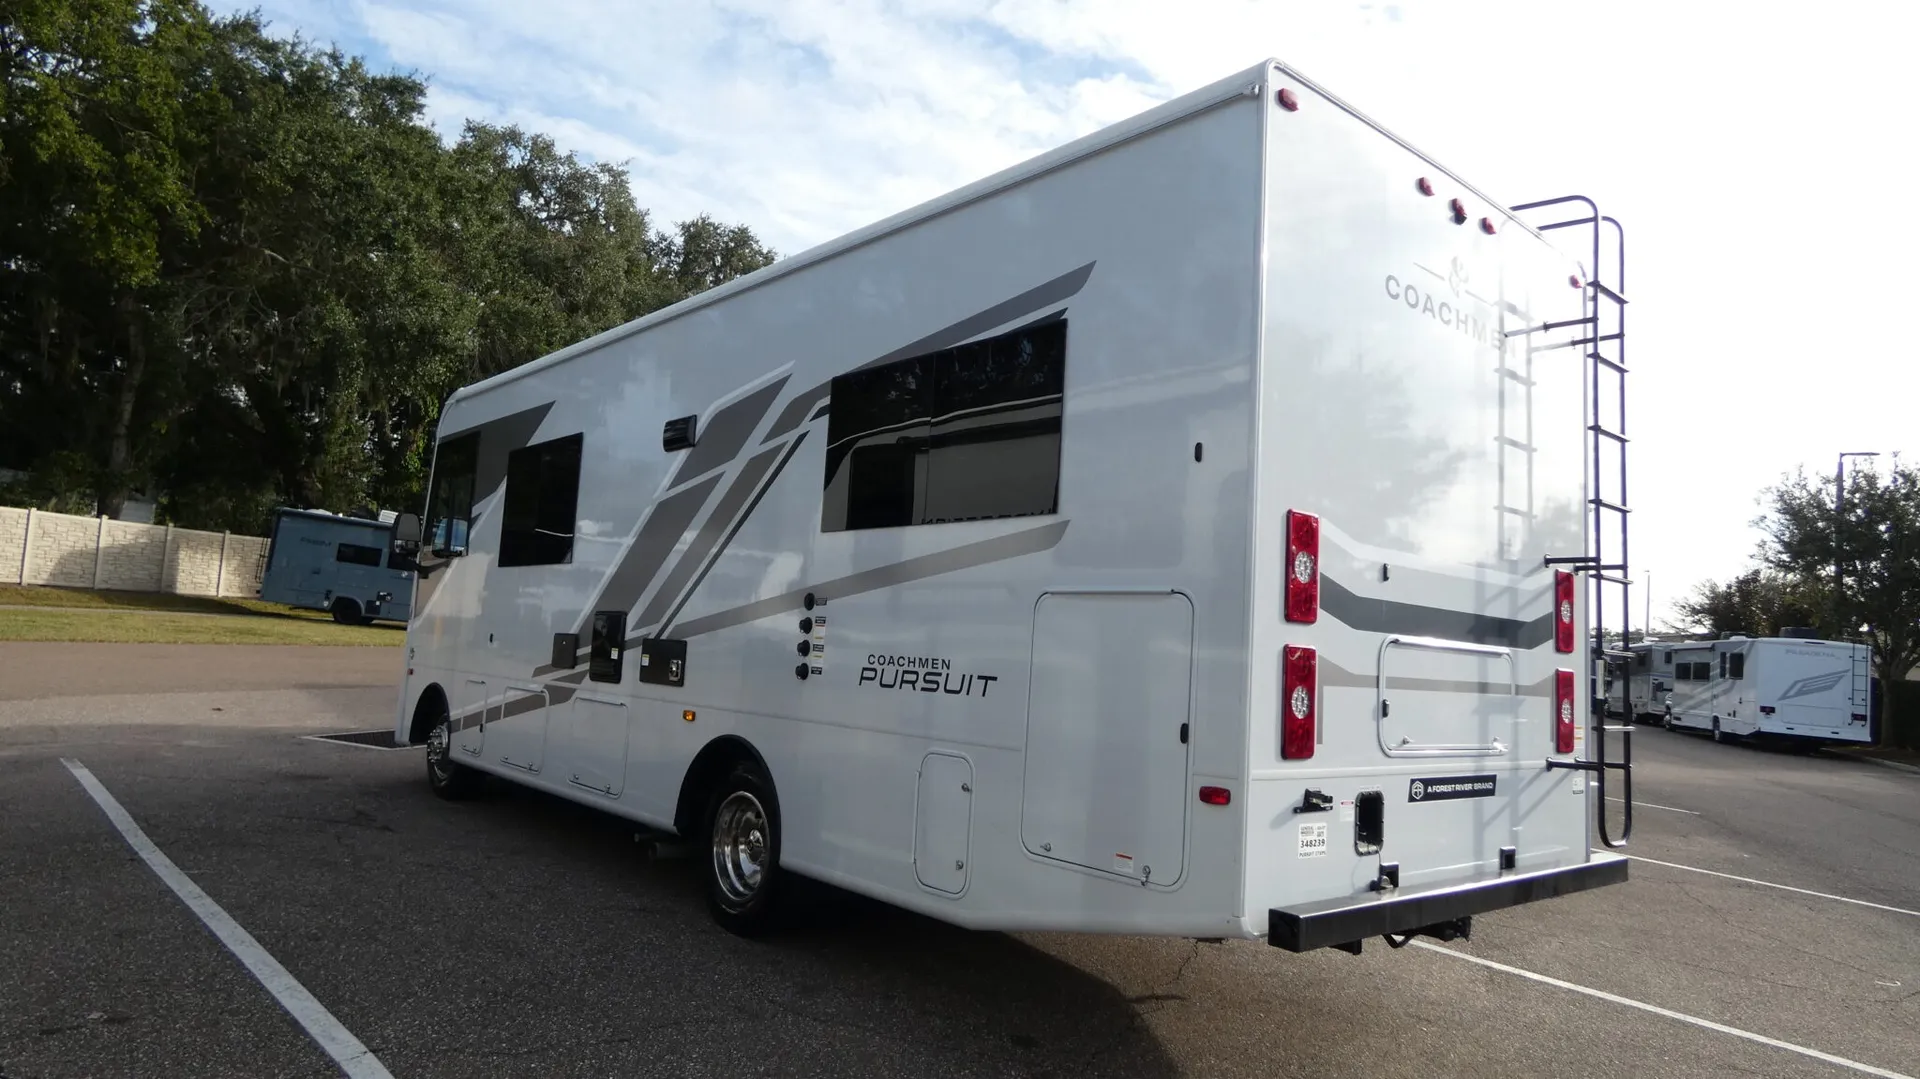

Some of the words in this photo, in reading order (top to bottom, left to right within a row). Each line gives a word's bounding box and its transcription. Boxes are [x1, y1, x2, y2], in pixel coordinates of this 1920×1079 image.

[867, 654, 951, 670] COACHMEN
[858, 667, 998, 697] PURSUIT
[1433, 784, 1455, 792] FOREST
[1456, 783, 1473, 791] RIVER
[1474, 782, 1494, 790] BRAND
[1300, 839, 1326, 848] 348239
